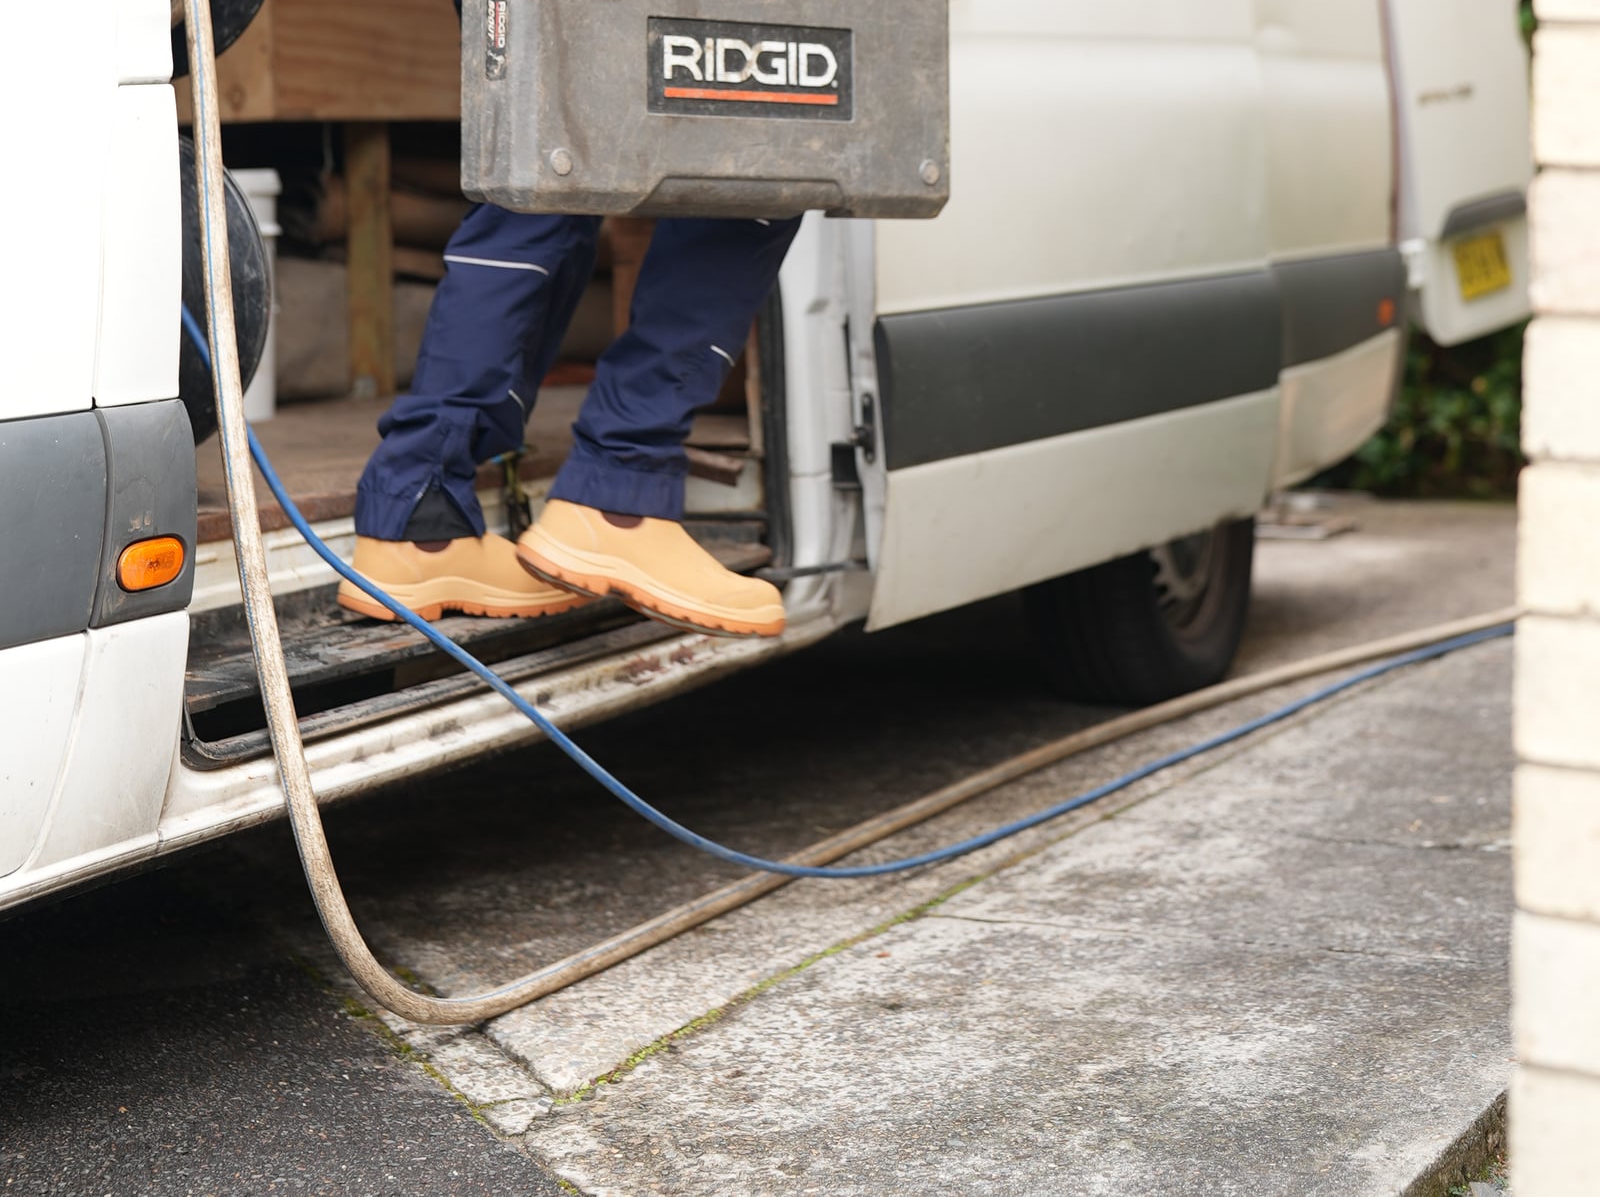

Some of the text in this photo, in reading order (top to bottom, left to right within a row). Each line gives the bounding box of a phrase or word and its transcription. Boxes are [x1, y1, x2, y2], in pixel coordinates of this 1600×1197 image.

[487, 0, 495, 41] SCOUT
[498, 1, 506, 48] RIDGID
[663, 35, 838, 87] RIDGID
